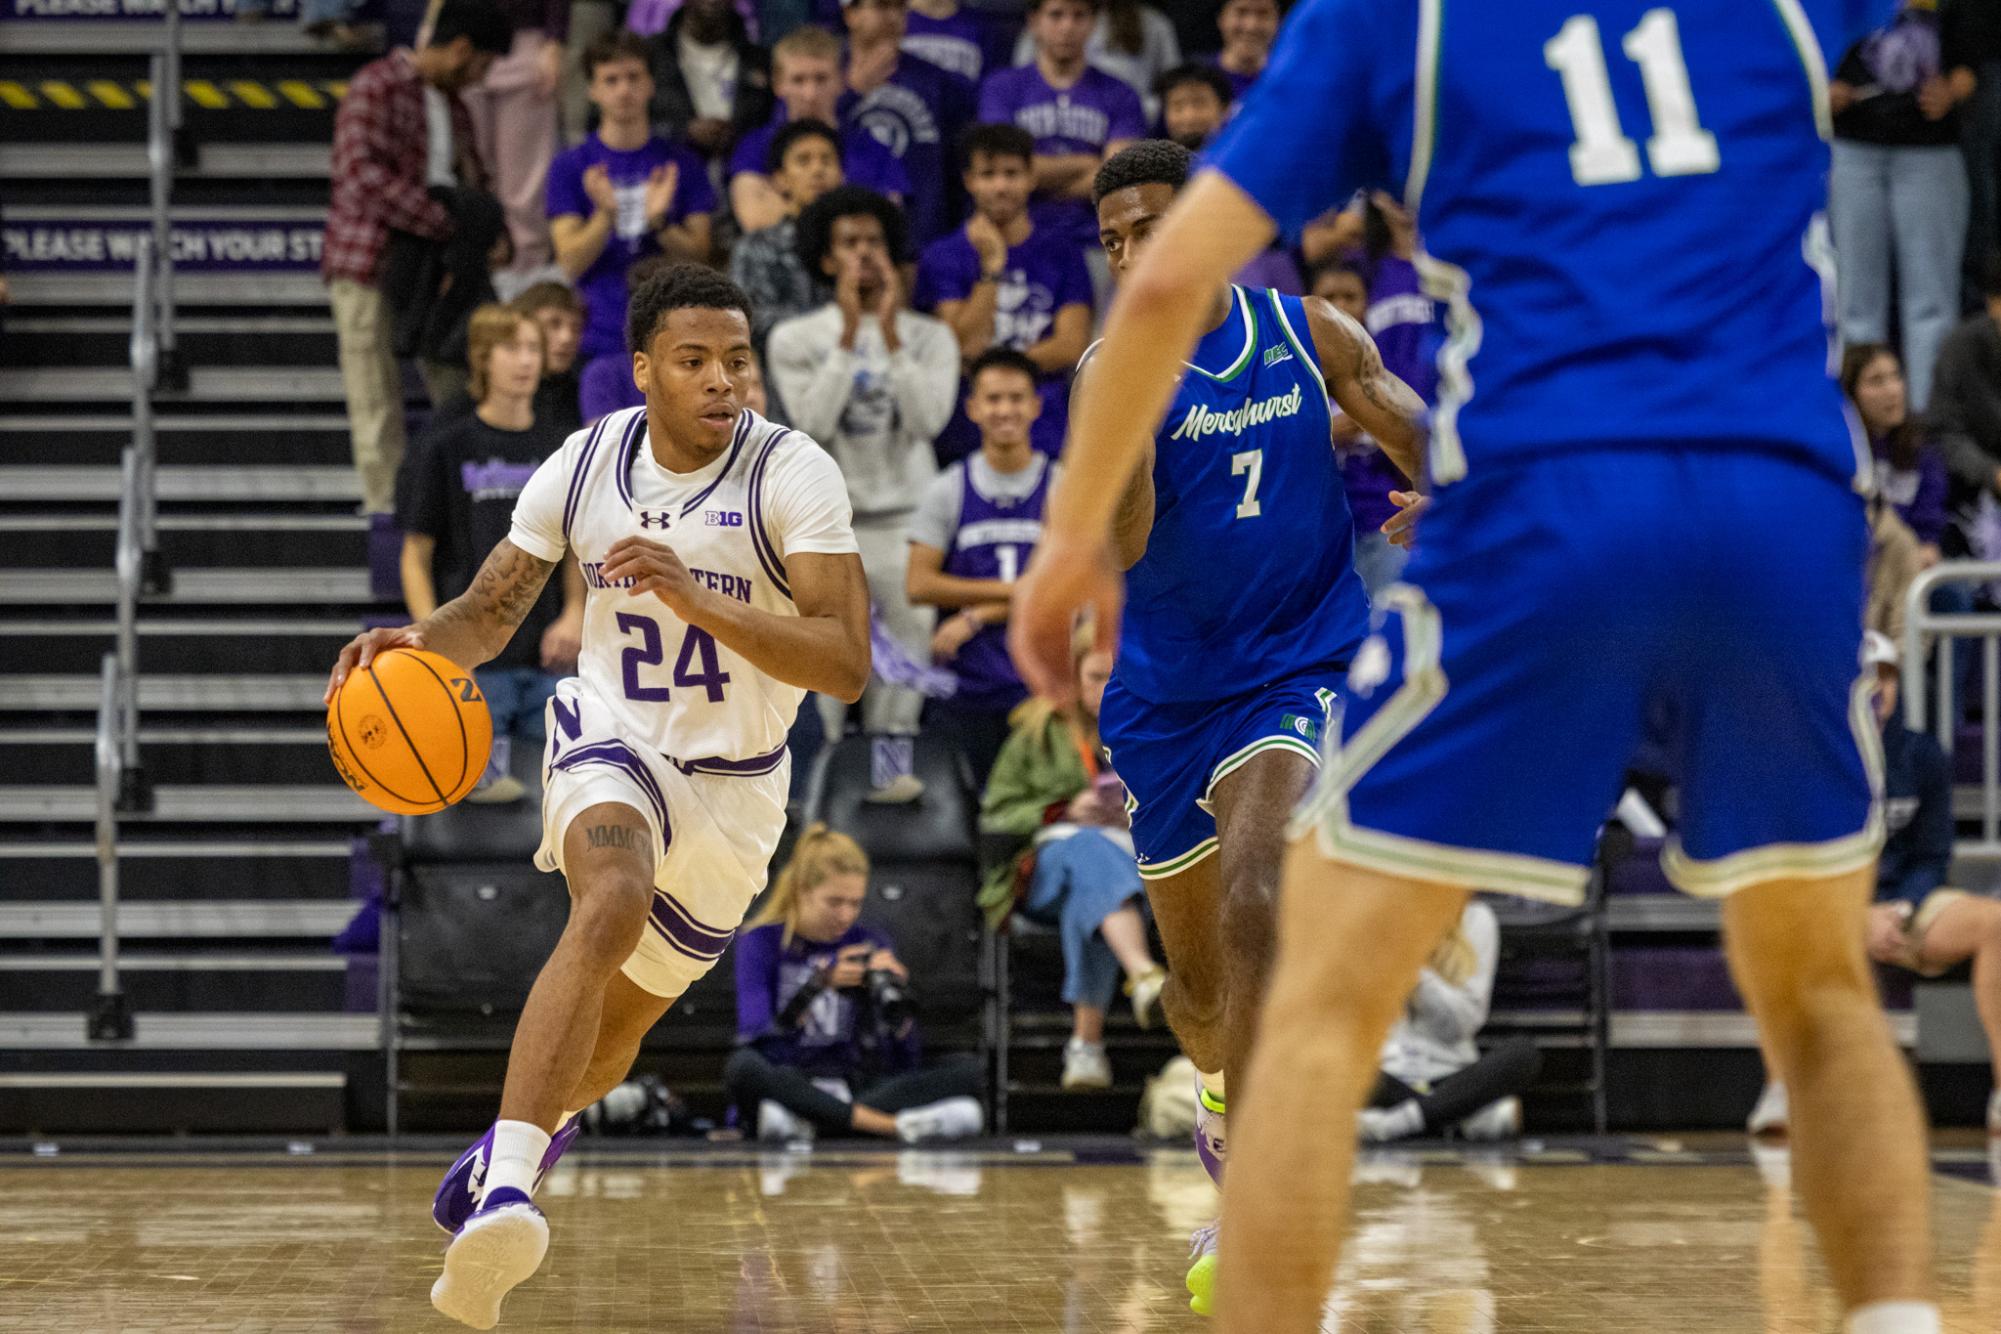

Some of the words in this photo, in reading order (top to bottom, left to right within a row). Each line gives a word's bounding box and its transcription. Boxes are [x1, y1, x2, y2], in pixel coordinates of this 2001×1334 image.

[1543, 7, 1721, 186] 11
[4, 229, 104, 261] PLEASE
[106, 230, 206, 261] WCH
[207, 229, 288, 261] YOUR
[289, 229, 322, 261] ST
[1171, 383, 1302, 441] Mercyhurst
[1231, 449, 1262, 519] 7
[995, 546, 1018, 584] 1
[615, 611, 731, 703] 24
